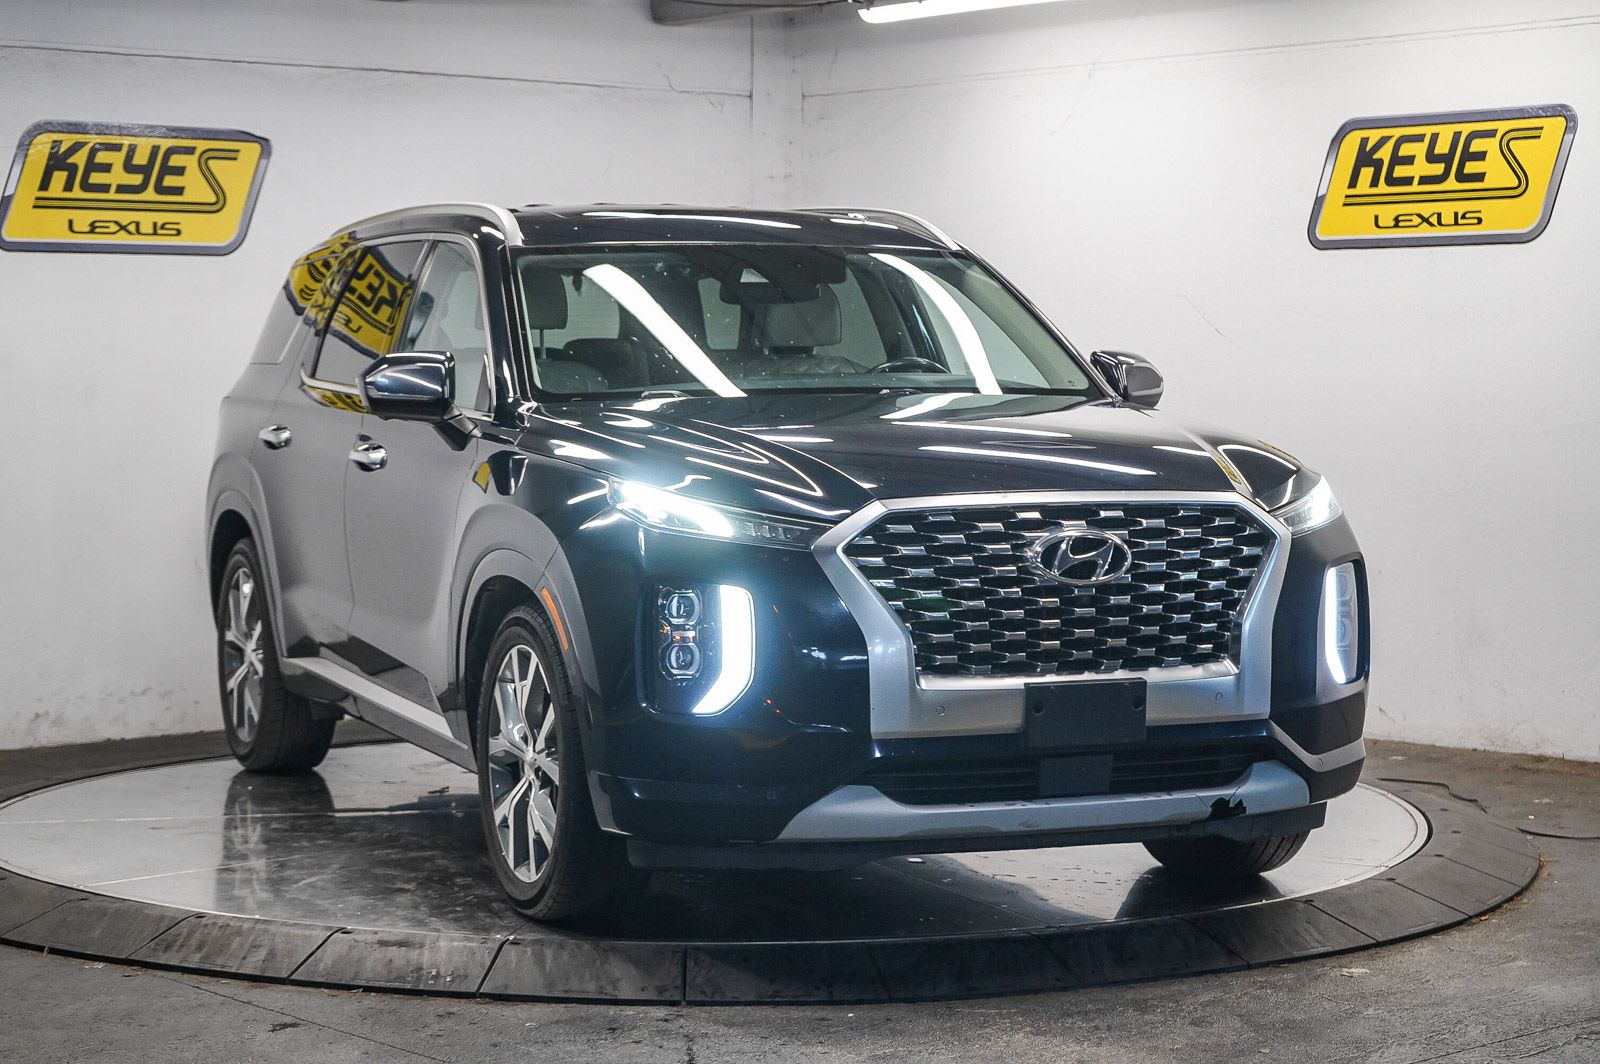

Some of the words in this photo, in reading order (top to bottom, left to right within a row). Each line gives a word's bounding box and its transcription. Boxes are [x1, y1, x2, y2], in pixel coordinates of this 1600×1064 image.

[33, 140, 240, 213] KEYES
[1343, 127, 1544, 207] KEYES
[68, 218, 182, 237] LEXUS
[1374, 210, 1483, 229] LEXUS
